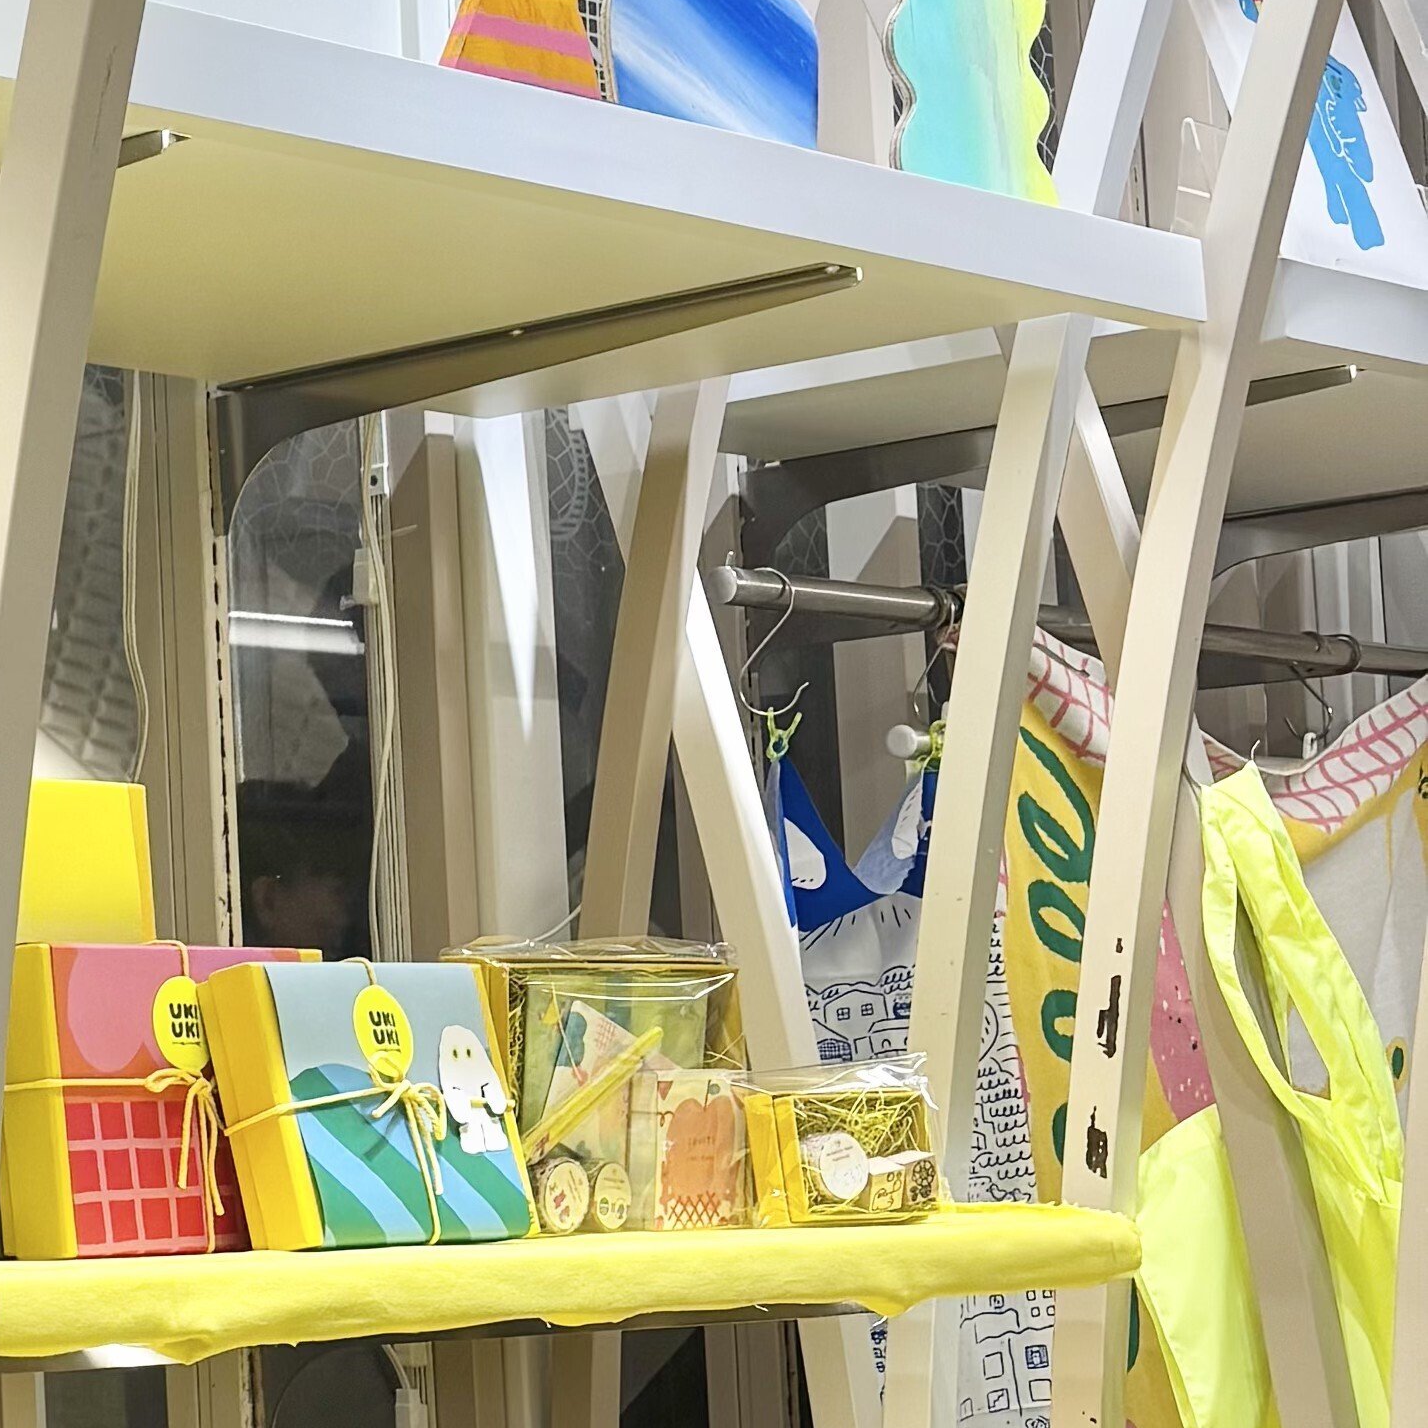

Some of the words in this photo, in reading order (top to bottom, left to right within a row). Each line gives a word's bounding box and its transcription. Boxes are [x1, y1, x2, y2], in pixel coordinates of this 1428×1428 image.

[168, 1002, 199, 1020] UKI
[368, 1010, 396, 1028] UKI
[171, 1021, 200, 1039] UKI
[372, 1028, 401, 1047] UKI
